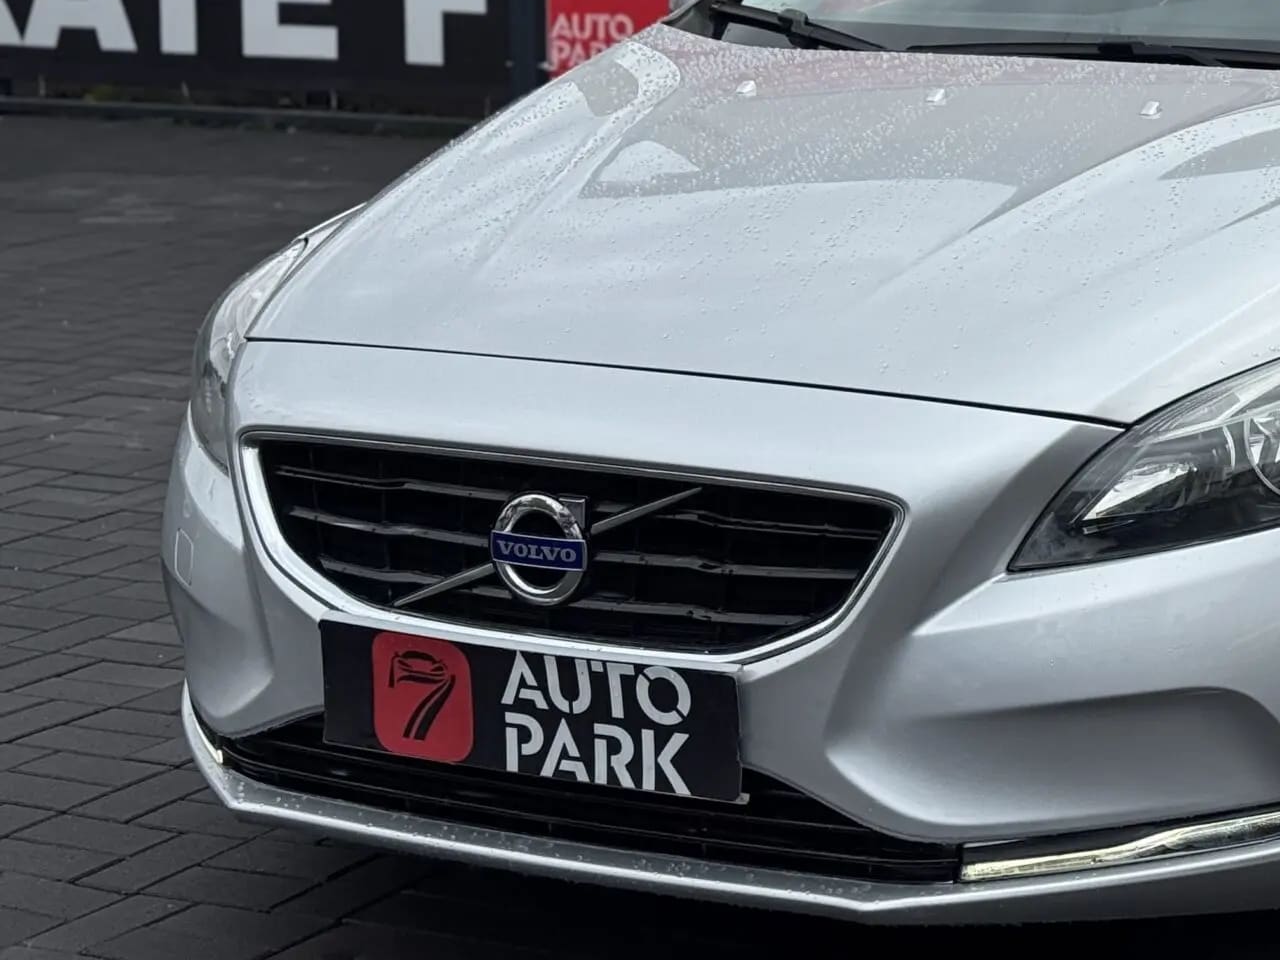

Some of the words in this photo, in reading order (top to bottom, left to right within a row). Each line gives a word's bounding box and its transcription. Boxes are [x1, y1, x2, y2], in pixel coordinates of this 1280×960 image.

[551, 13, 634, 40] AUTO
[496, 540, 577, 562] VOLVO
[501, 650, 692, 726] AUTO
[504, 711, 692, 796] PARK
